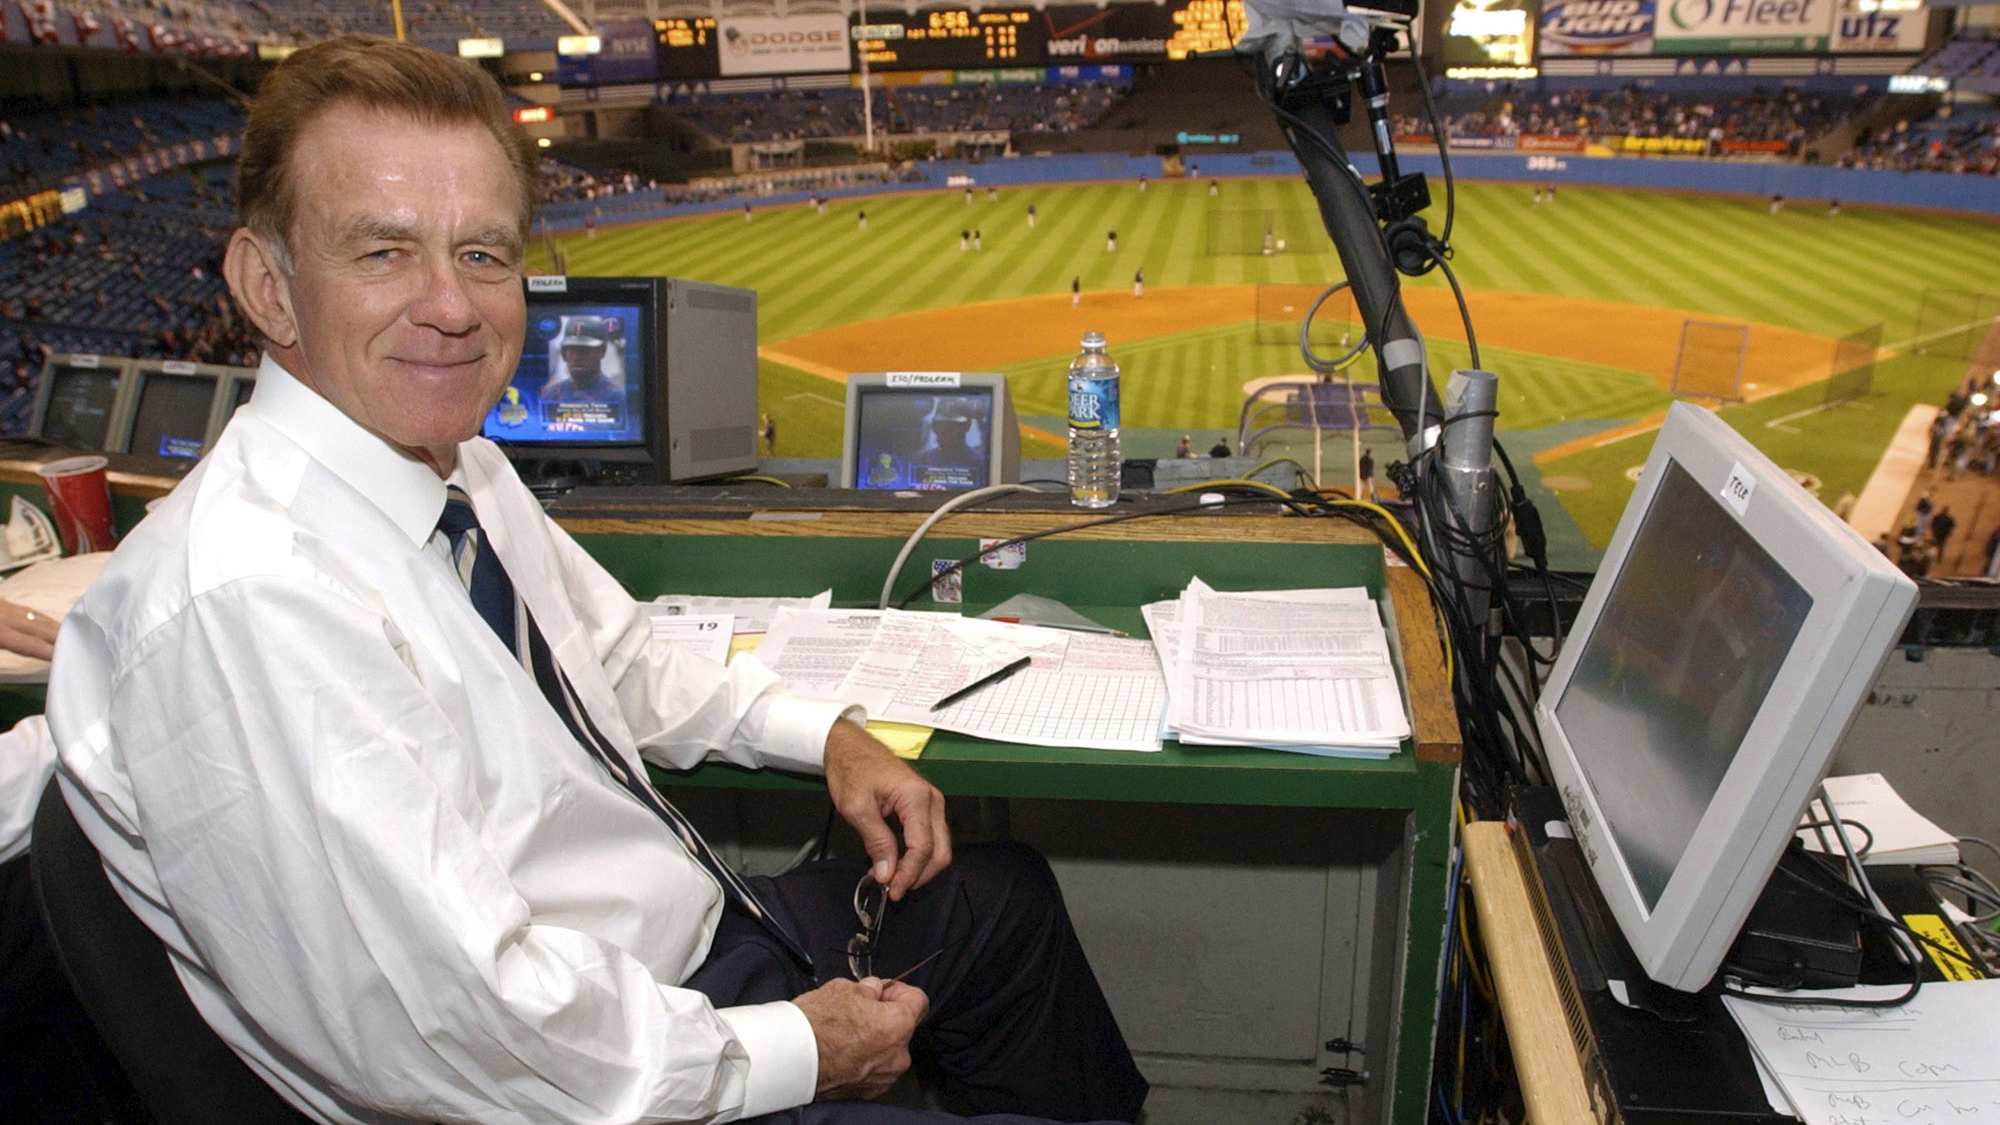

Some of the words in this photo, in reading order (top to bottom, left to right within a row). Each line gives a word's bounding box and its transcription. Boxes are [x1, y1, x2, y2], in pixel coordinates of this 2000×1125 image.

[1722, 0, 1809, 24] Fleet
[1545, 14, 1653, 33] LIGHT
[1842, 10, 1898, 38] utz
[751, 29, 842, 45] DODGE
[1048, 34, 1120, 57] verizon
[1069, 405, 1101, 419] ARK
